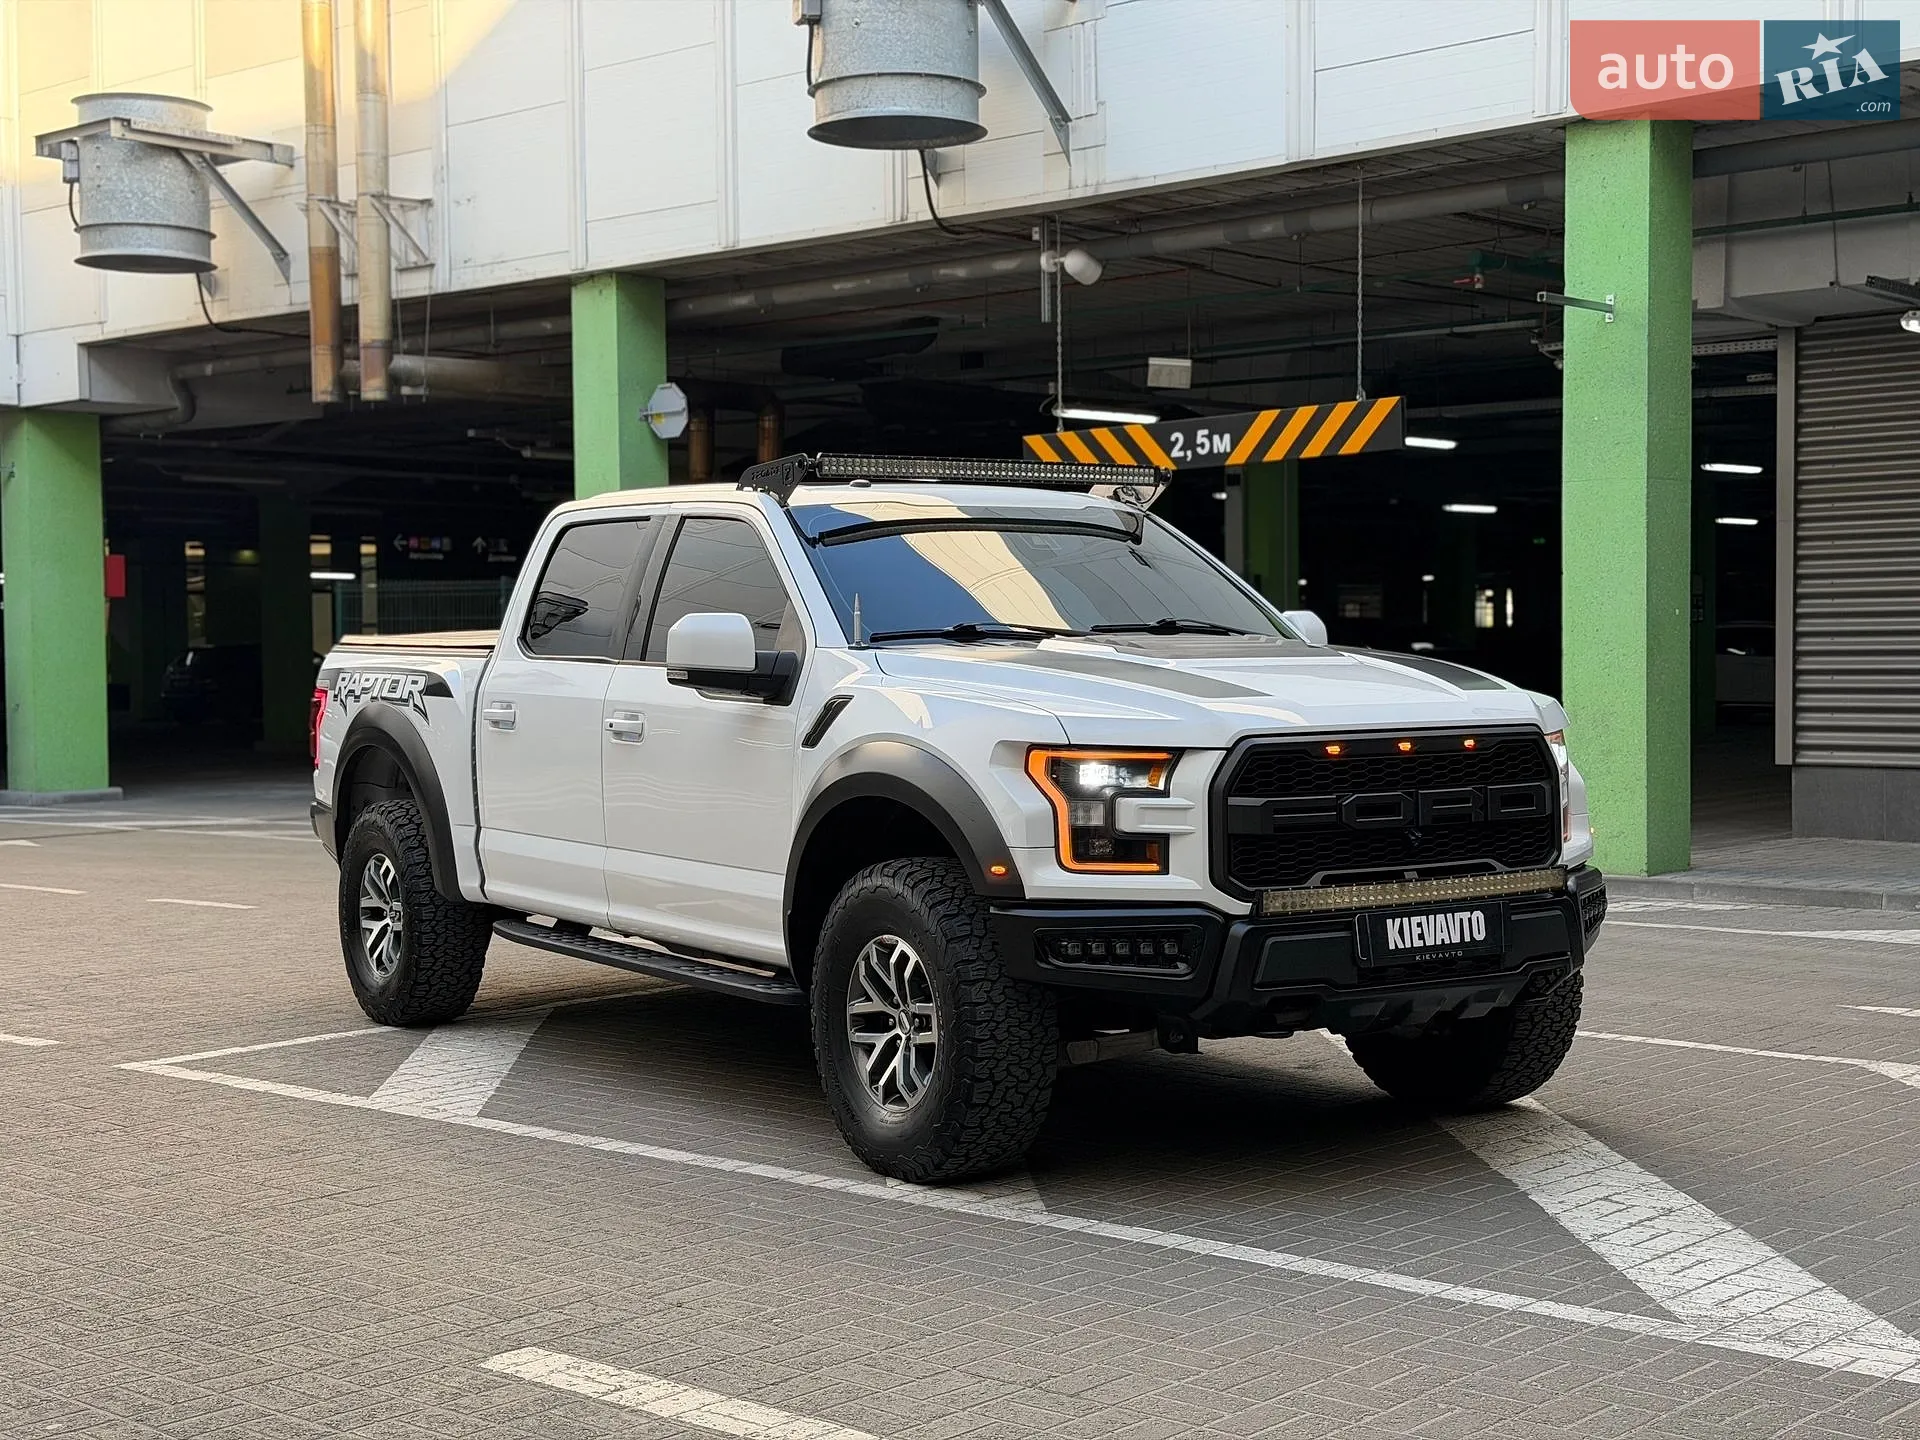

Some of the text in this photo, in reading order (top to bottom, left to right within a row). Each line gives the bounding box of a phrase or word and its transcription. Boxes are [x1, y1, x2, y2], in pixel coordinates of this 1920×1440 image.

[333, 671, 429, 724] RAPTOR
[1228, 782, 1551, 834] FORD
[1386, 910, 1486, 950] KIEVAVTO
[1415, 950, 1463, 961] KIEVAVTO
